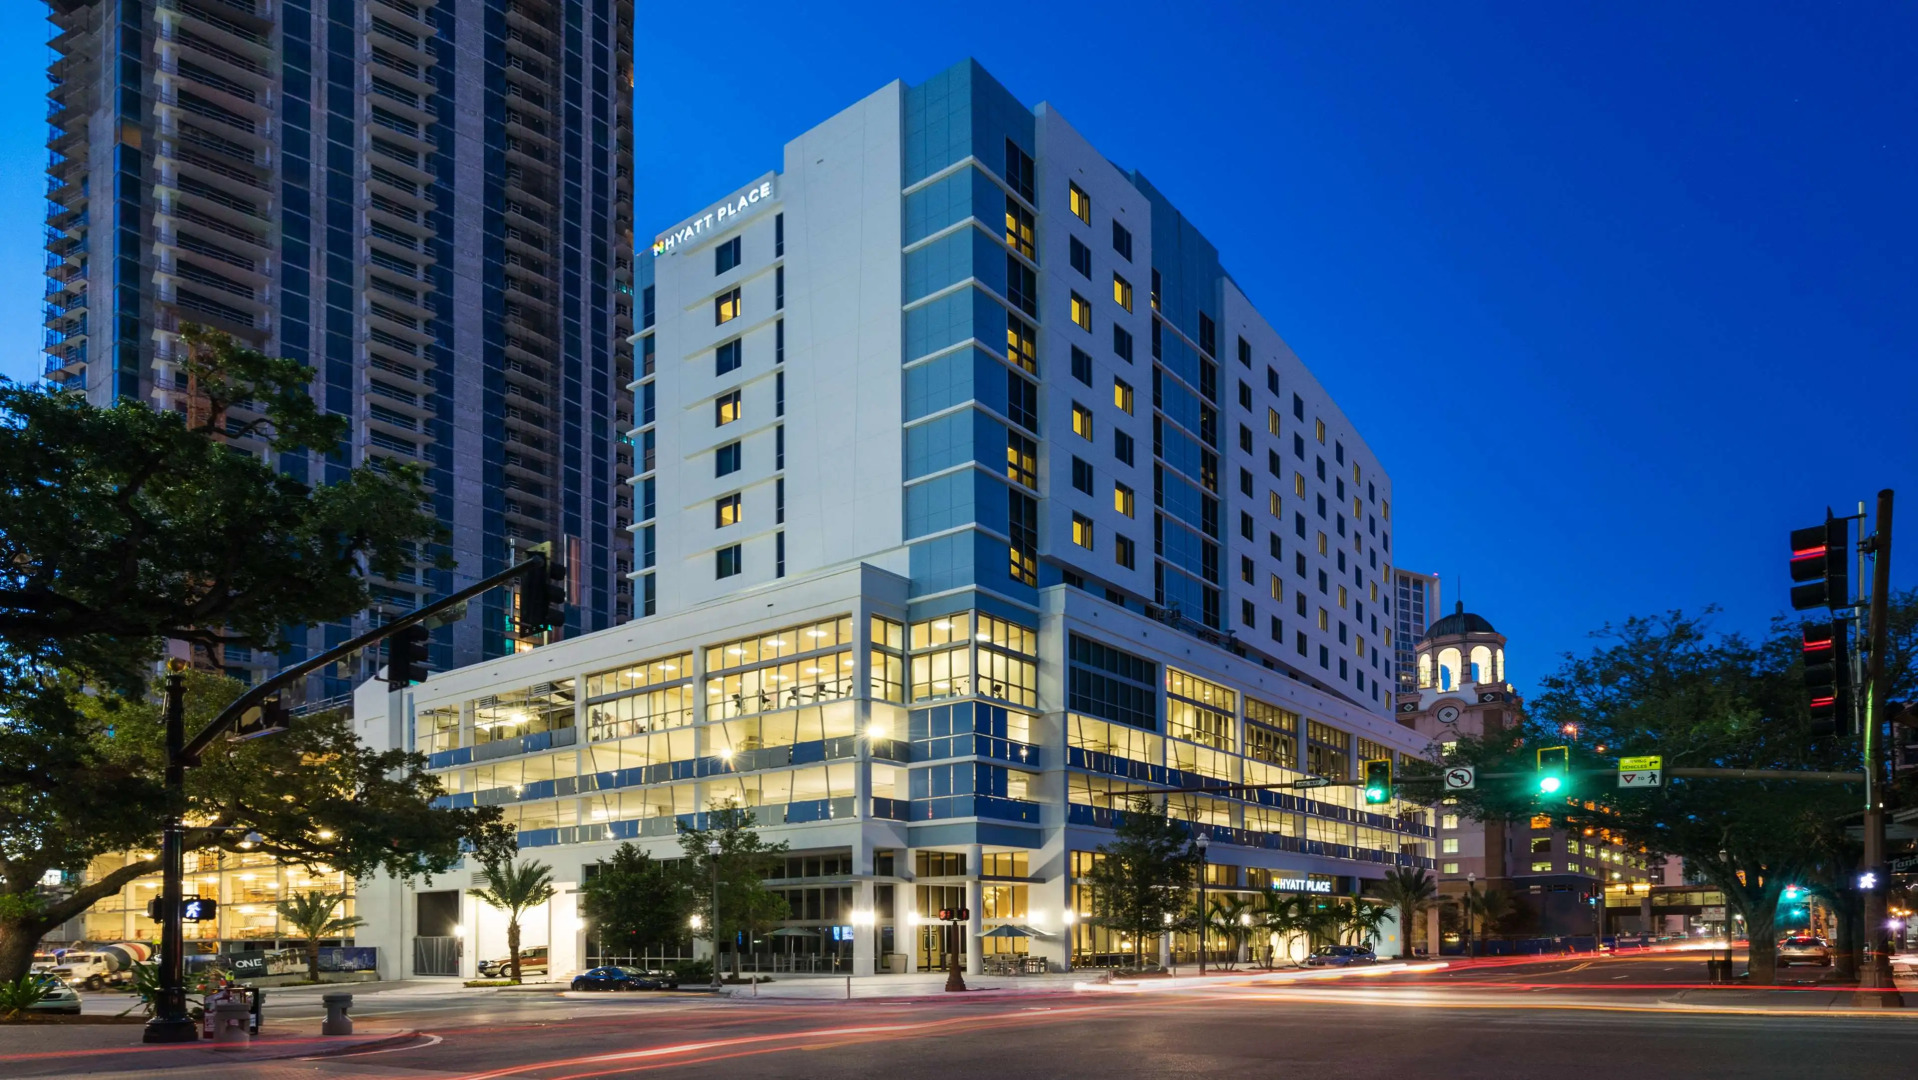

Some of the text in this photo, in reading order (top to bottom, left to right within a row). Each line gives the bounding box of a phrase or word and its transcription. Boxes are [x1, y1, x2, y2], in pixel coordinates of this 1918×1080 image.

[665, 213, 713, 251] HYATT
[717, 182, 771, 222] PLACE
[1280, 878, 1306, 891] HYATT
[1306, 880, 1331, 893] PLACE
[235, 958, 263, 968] ONE
